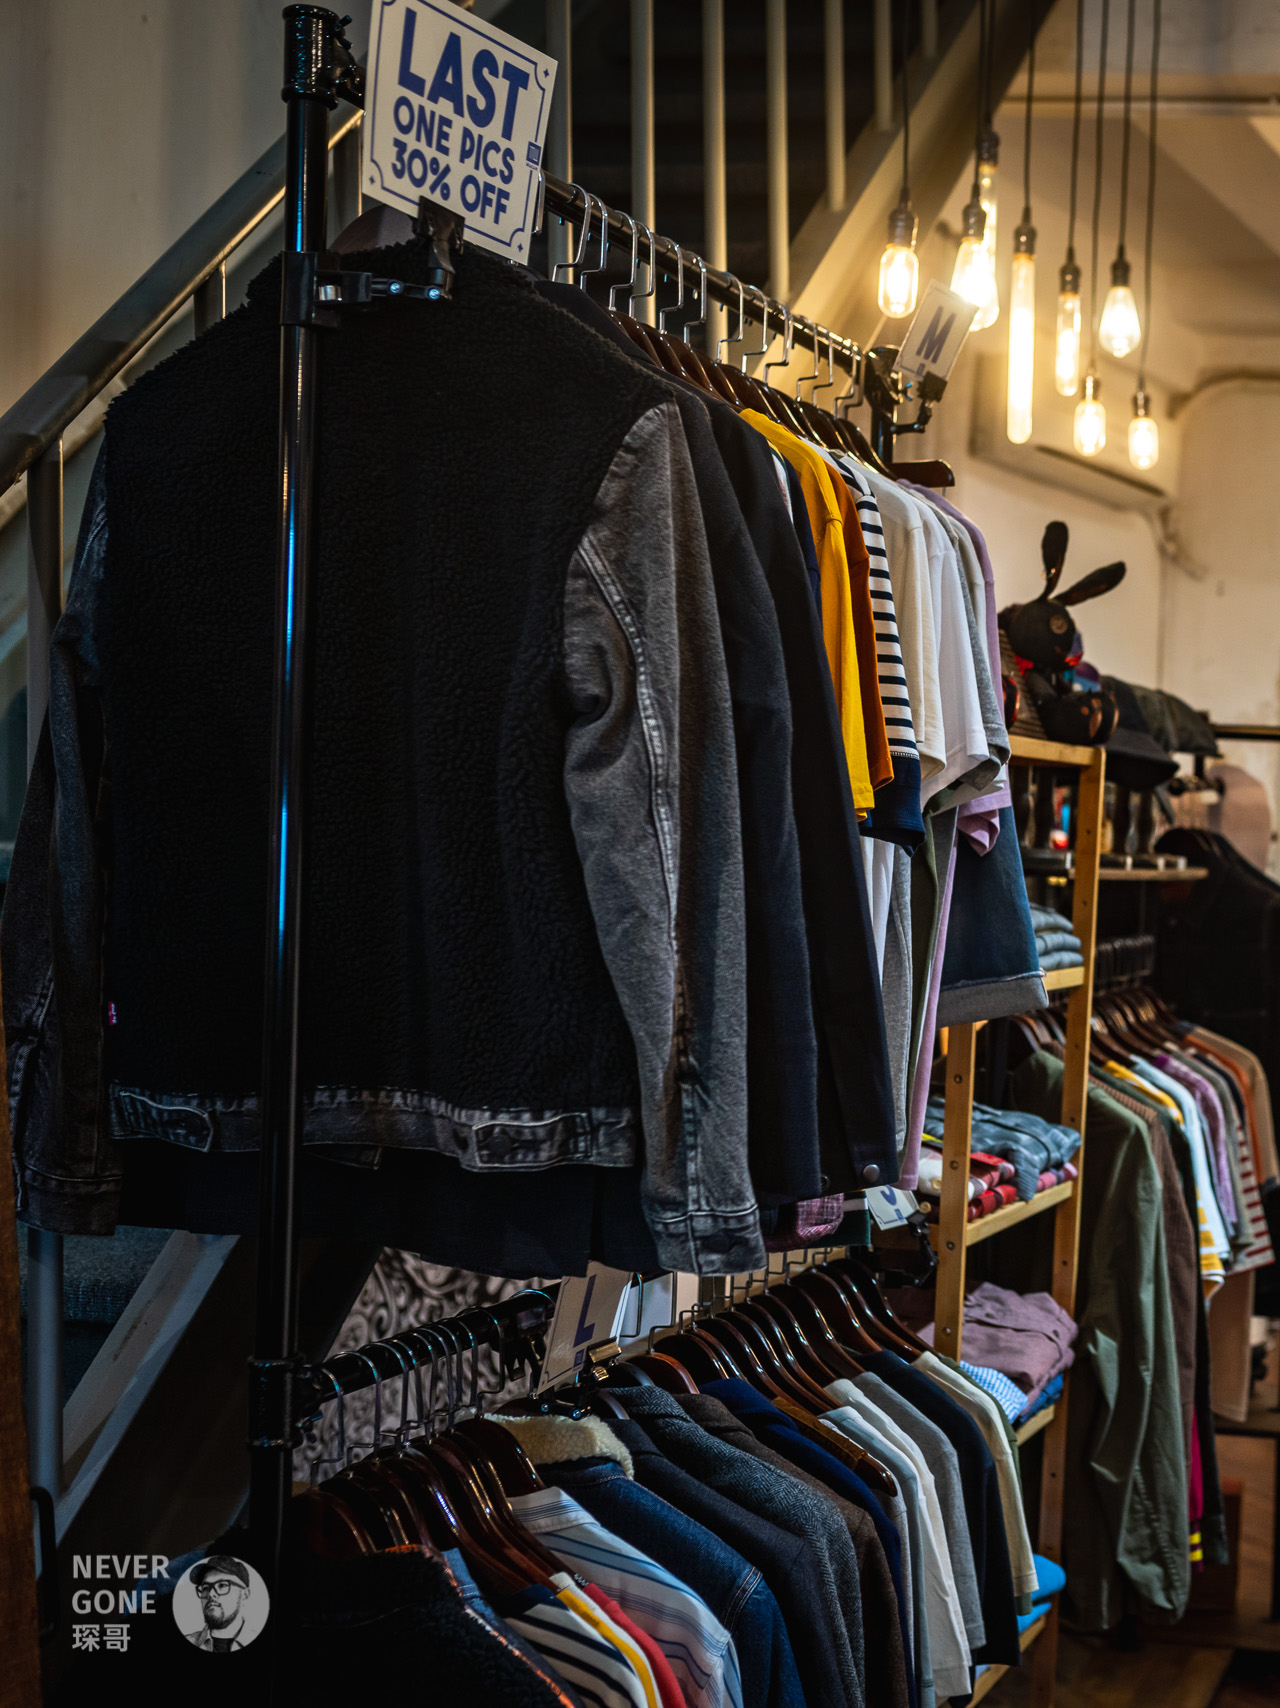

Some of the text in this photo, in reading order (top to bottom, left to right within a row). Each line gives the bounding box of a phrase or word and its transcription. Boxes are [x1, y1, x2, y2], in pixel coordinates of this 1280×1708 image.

[397, 7, 530, 141] LAST
[391, 137, 510, 225] 30% OFF
[393, 95, 515, 184] ONE PICS
[915, 305, 957, 364] M
[573, 1274, 597, 1348] L
